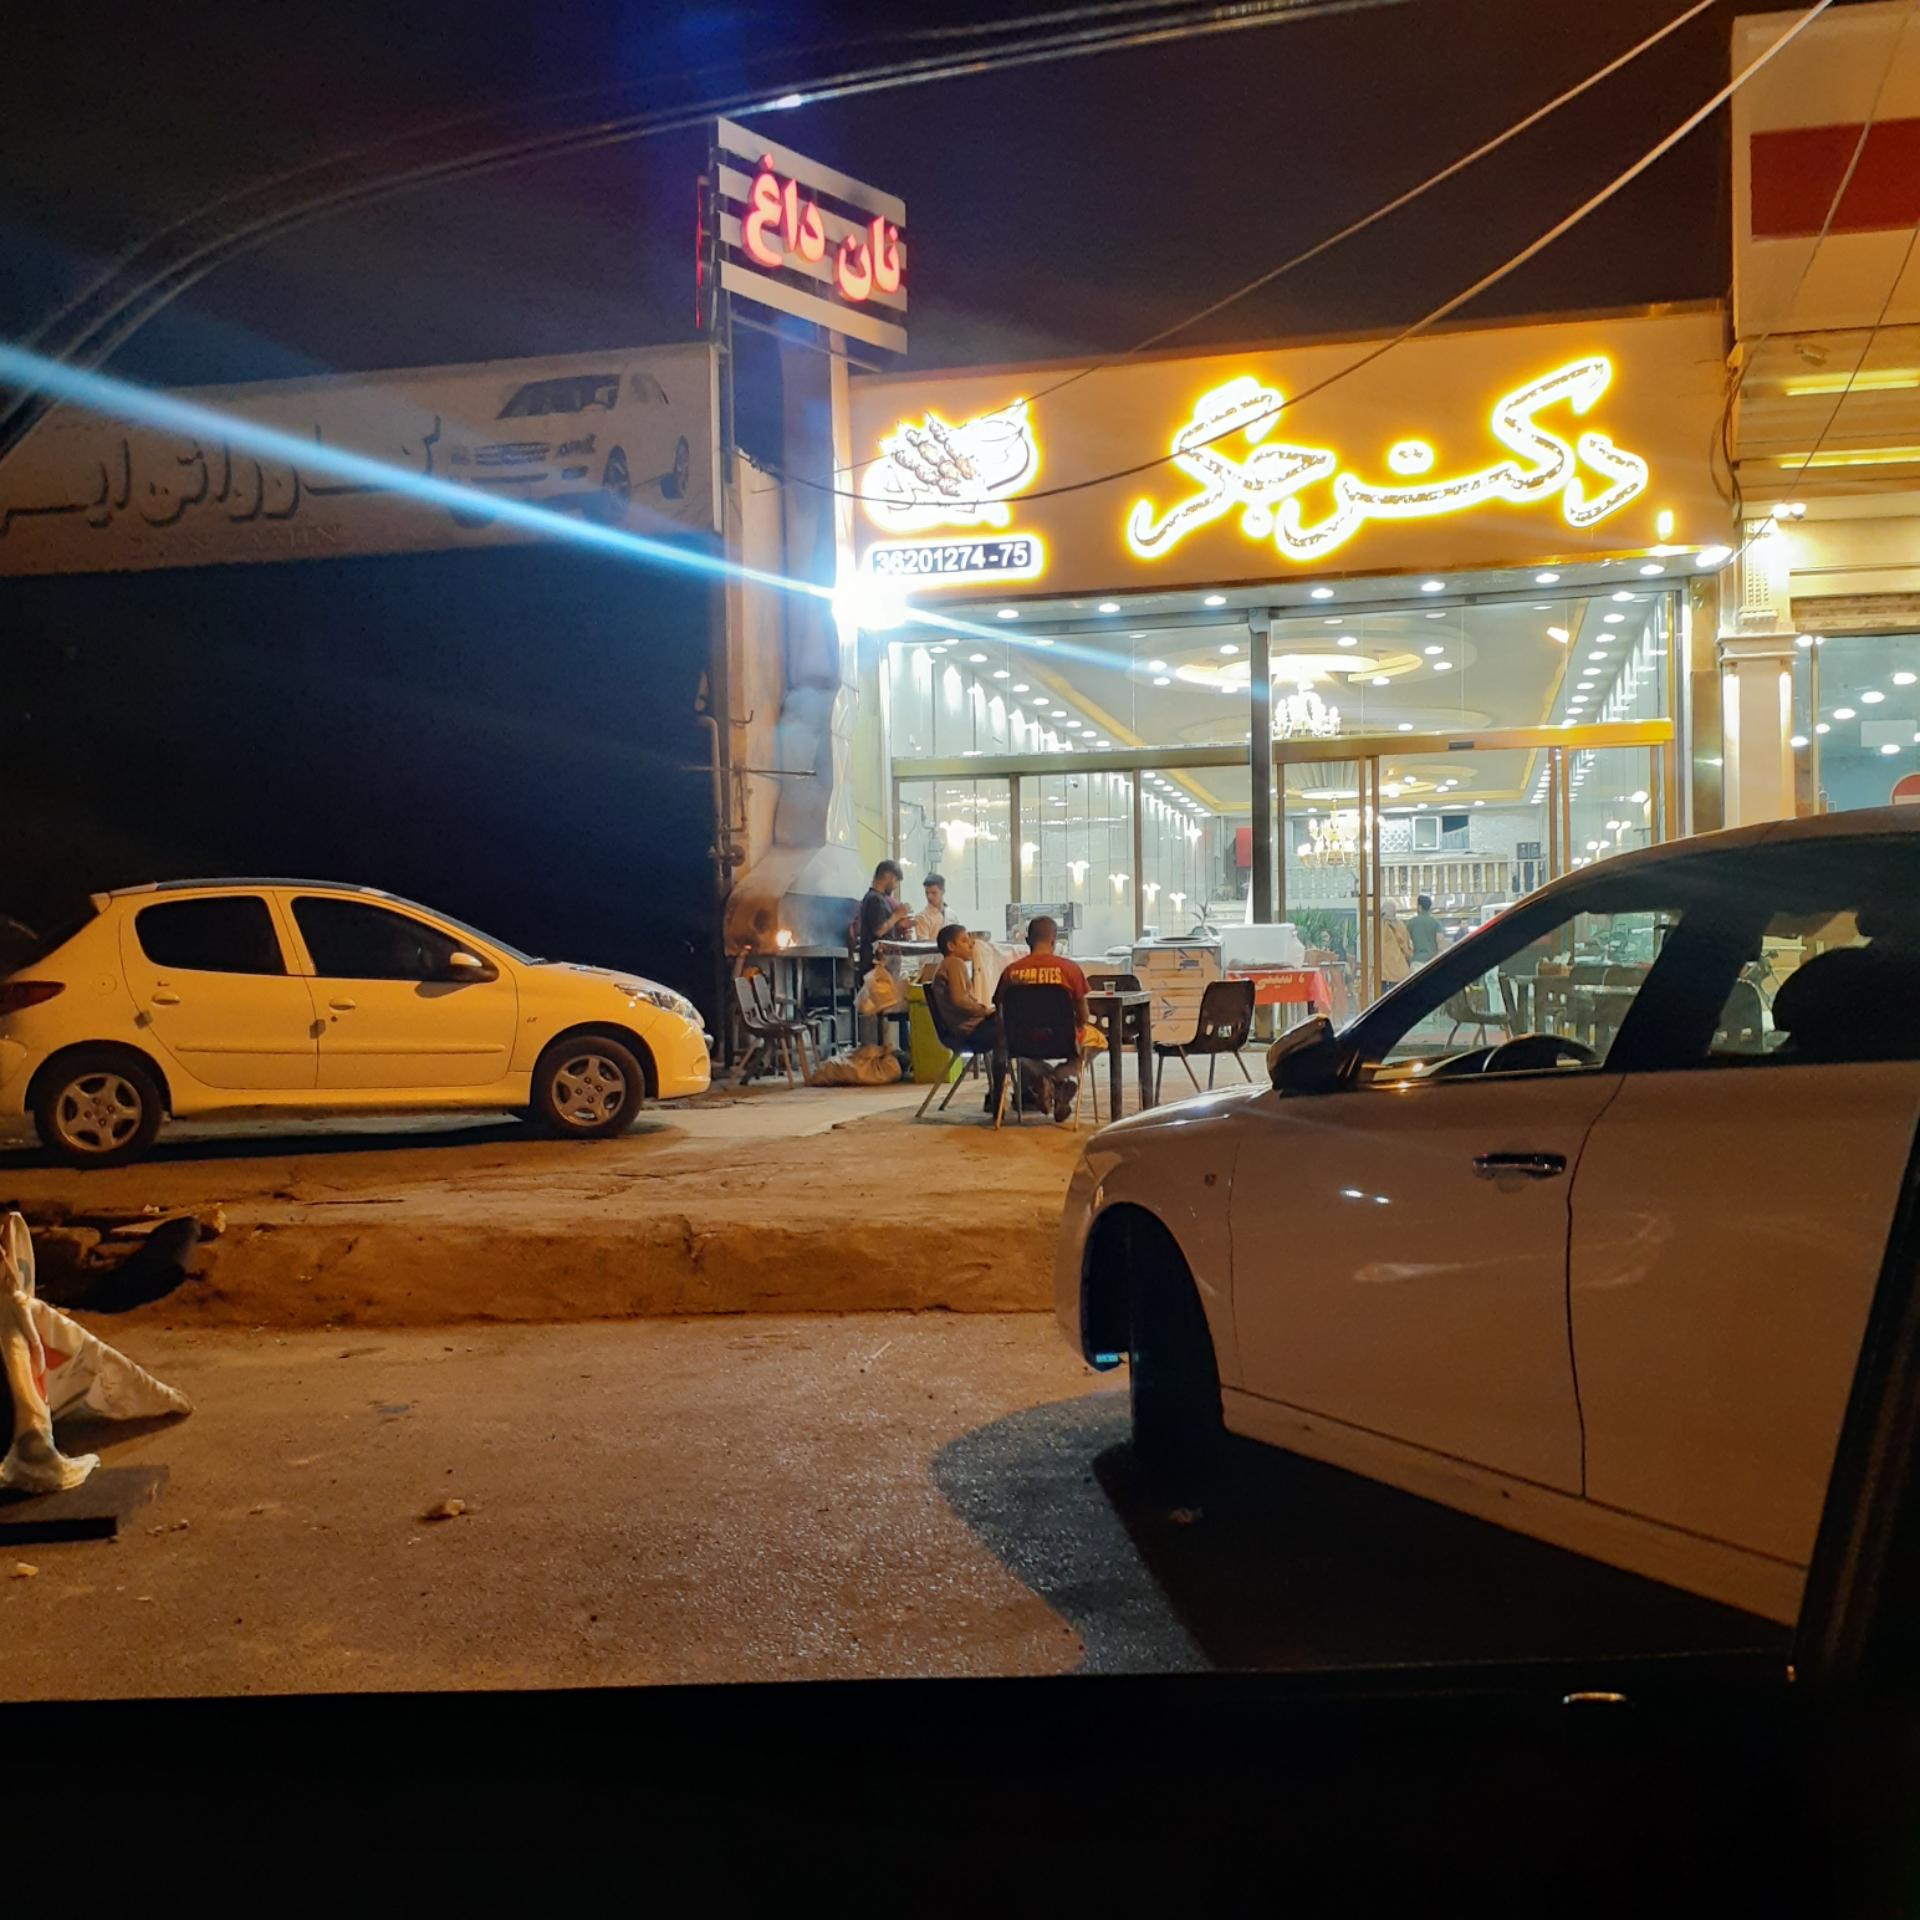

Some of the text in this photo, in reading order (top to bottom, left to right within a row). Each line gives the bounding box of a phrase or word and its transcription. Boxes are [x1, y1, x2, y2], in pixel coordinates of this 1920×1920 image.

[742, 153, 902, 302] نان داغ
[1127, 355, 1650, 560] دکتر جگر
[1038, 966, 1062, 984] EYES
